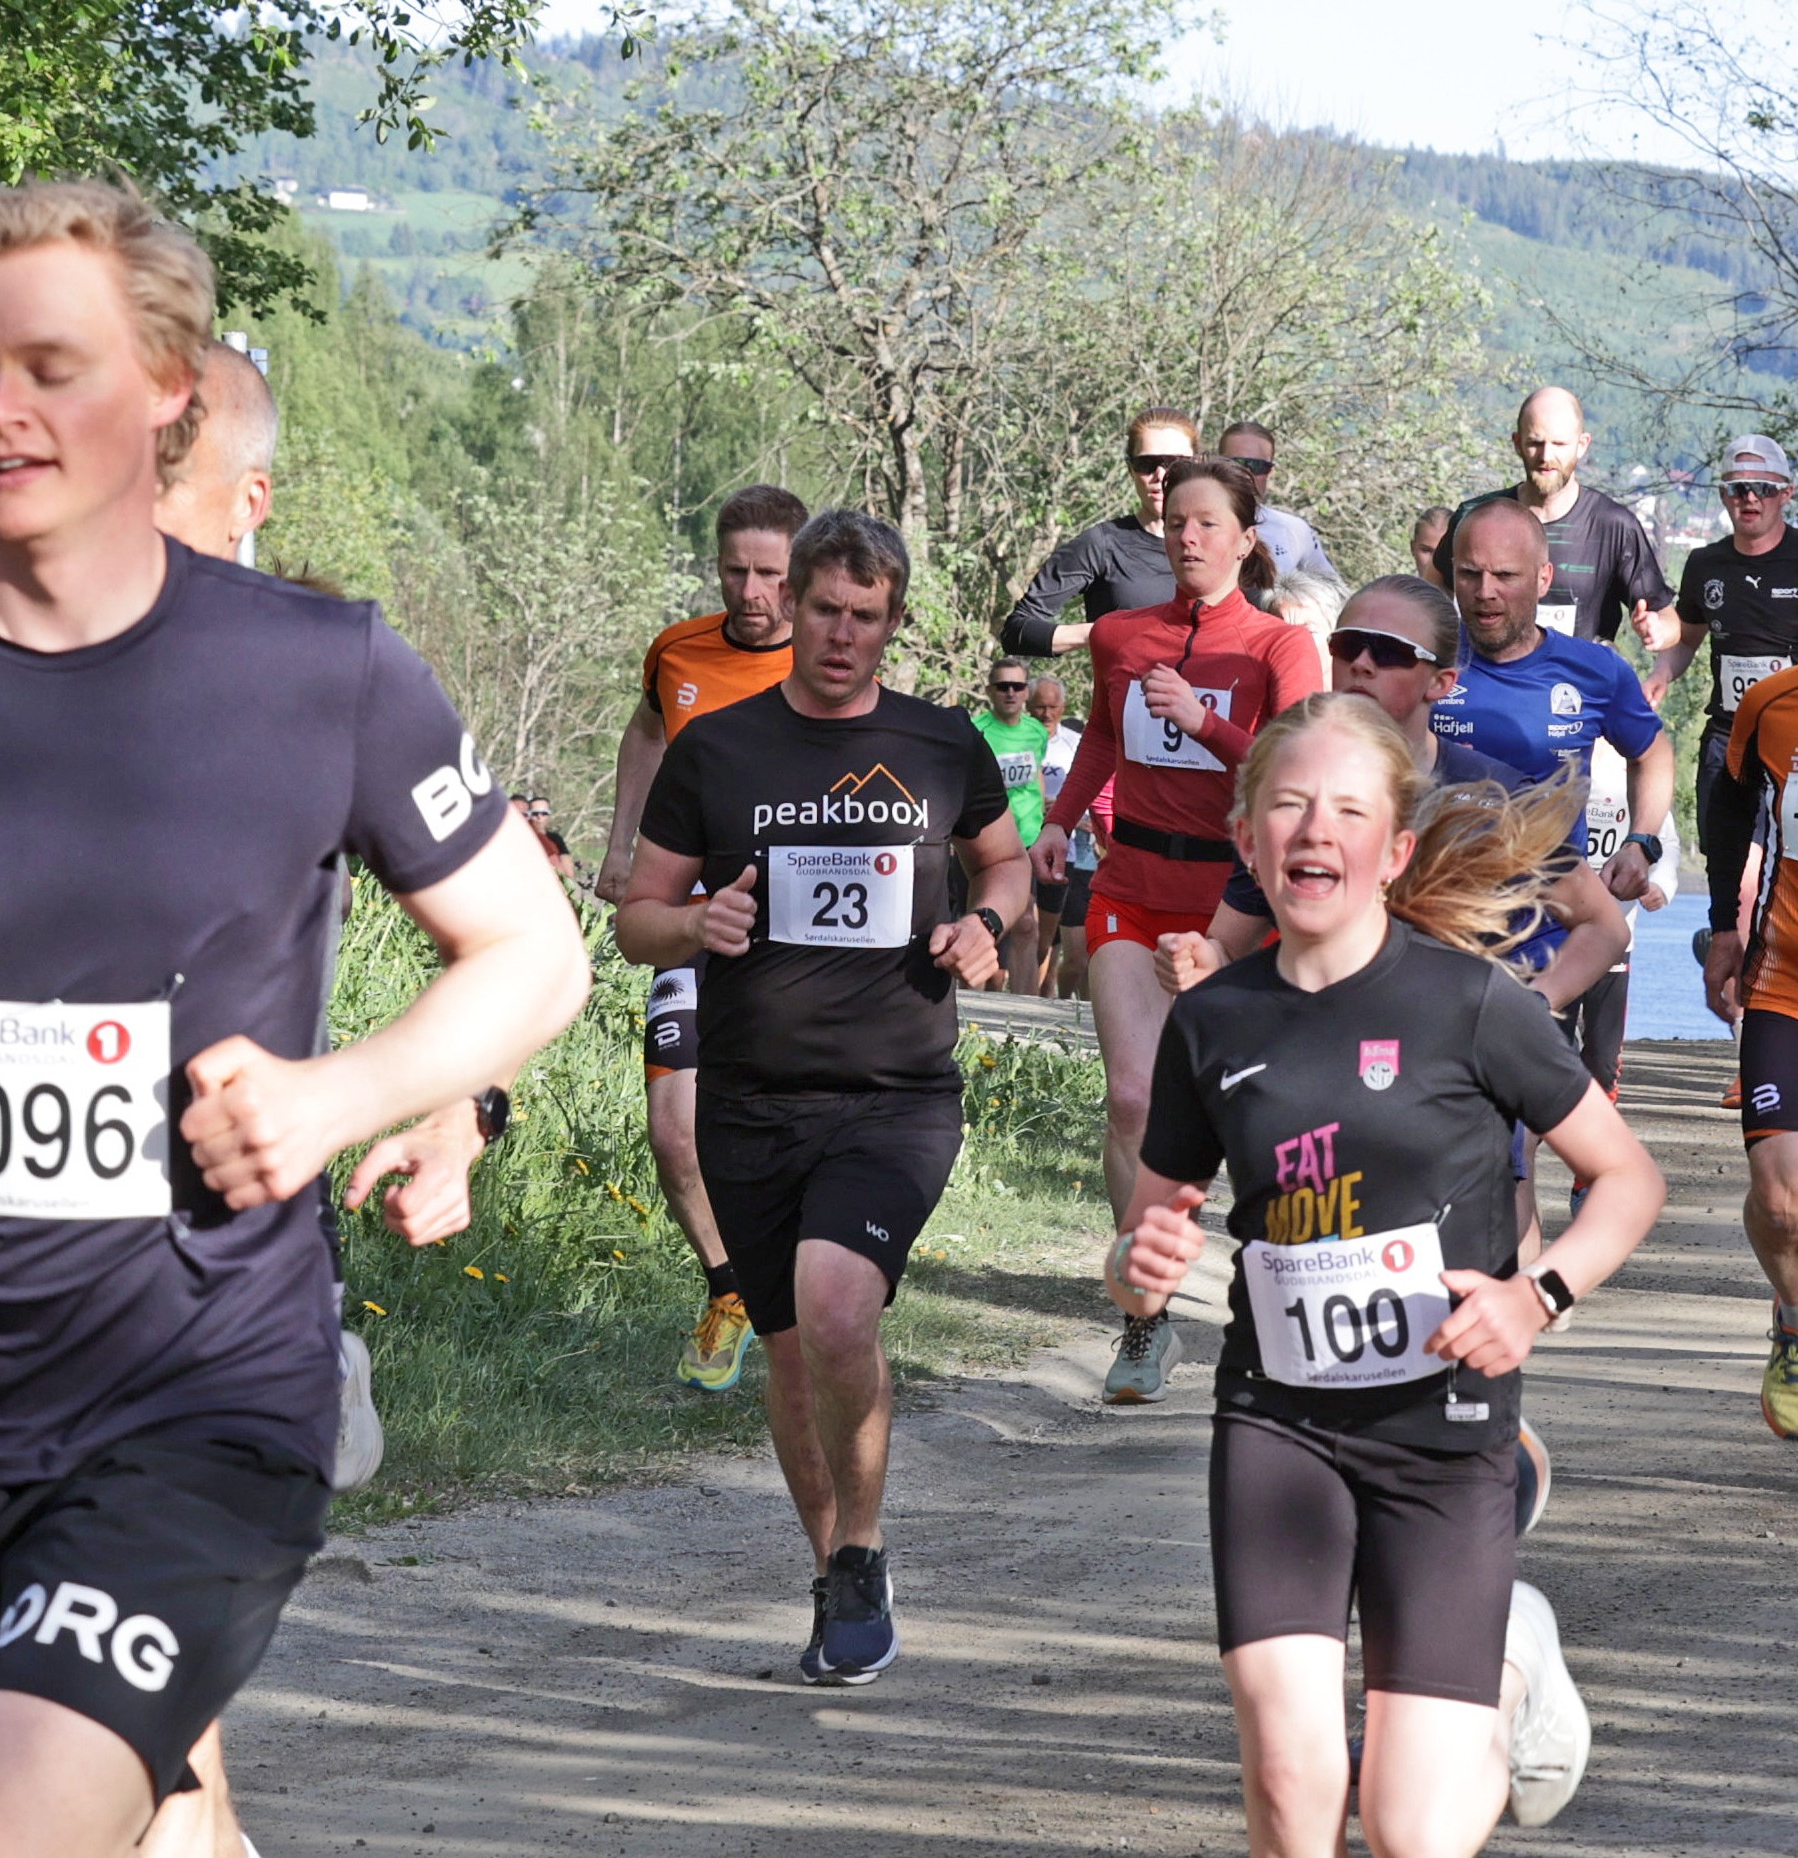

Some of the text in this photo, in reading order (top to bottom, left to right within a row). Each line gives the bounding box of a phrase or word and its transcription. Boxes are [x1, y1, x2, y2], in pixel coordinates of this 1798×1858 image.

[1728, 659, 1768, 669] SpareBank
[1434, 721, 1474, 736] Hafjell
[1001, 764, 1033, 782] 1077
[754, 795, 929, 835] peakbook
[787, 852, 871, 868] SpareBank
[796, 868, 872, 876] GUDBRANDSDAL
[811, 881, 869, 929] 23
[804, 933, 876, 944] Sørdalskarusellen
[1275, 1121, 1341, 1194] EAT
[1266, 1170, 1364, 1244] MOVE
[1262, 1248, 1376, 1274] SpareBank
[1285, 1288, 1410, 1364] 100
